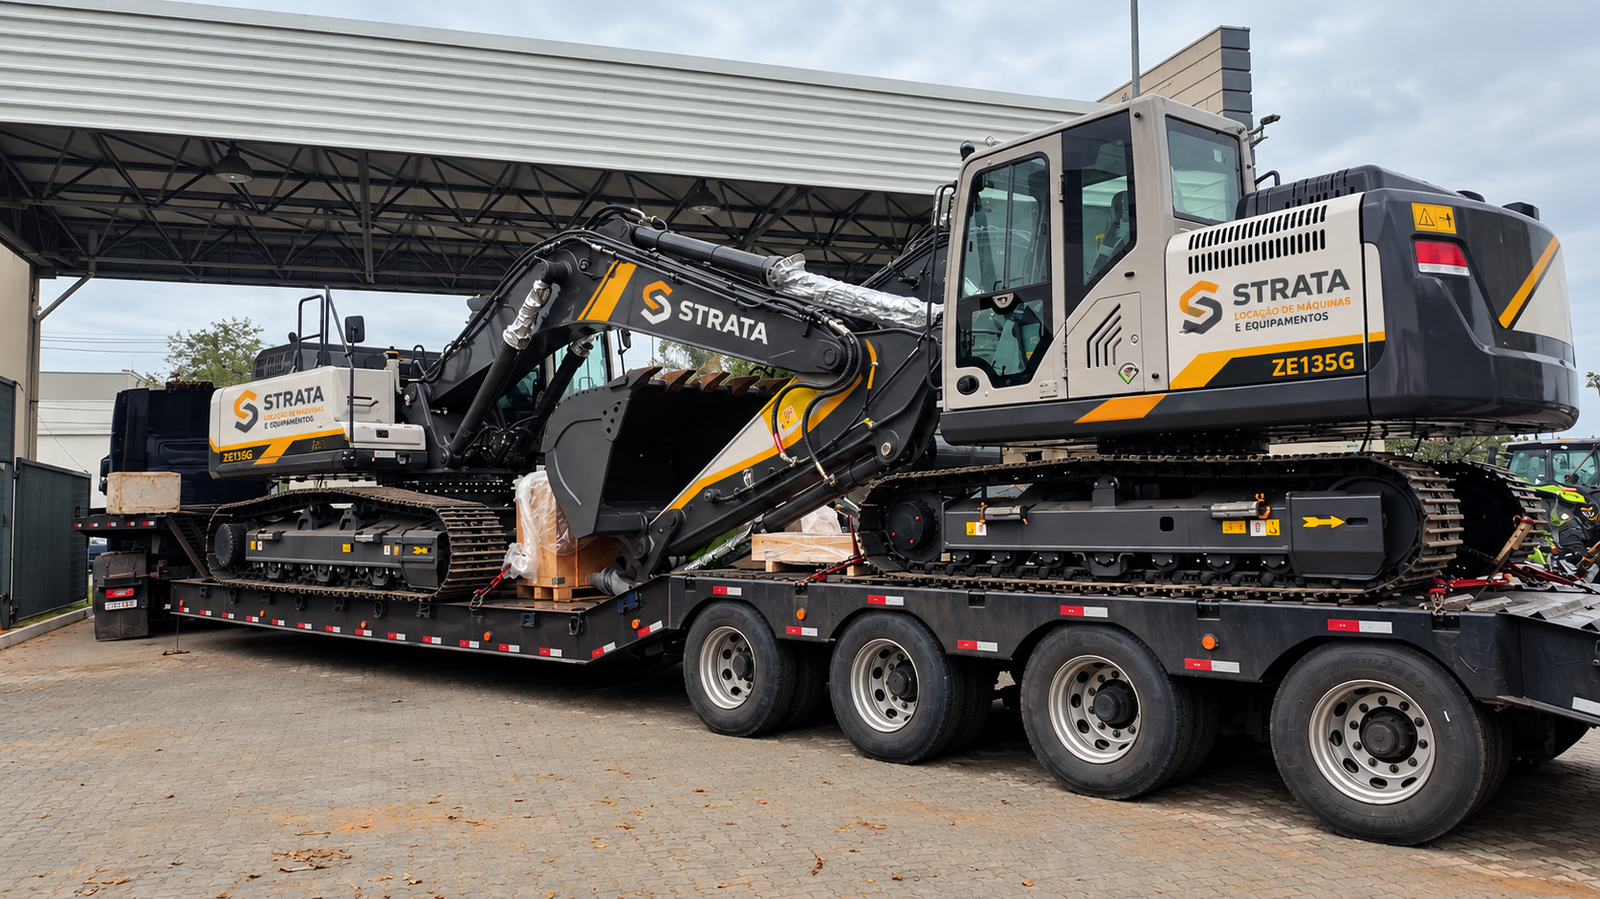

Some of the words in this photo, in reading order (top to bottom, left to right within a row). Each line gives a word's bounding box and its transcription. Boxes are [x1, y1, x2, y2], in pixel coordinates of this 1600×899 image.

[1233, 268, 1351, 306] STRATA
[1234, 305, 1280, 321] LOCAÇÃO
[1282, 303, 1295, 315] DE
[1296, 296, 1352, 313] MÁQUINAS
[678, 300, 768, 345] STRATA
[1235, 322, 1242, 332] E
[1245, 312, 1329, 331] EQUIPAMENTOS
[1272, 351, 1355, 377] ZE135G
[264, 386, 325, 410] STRATA
